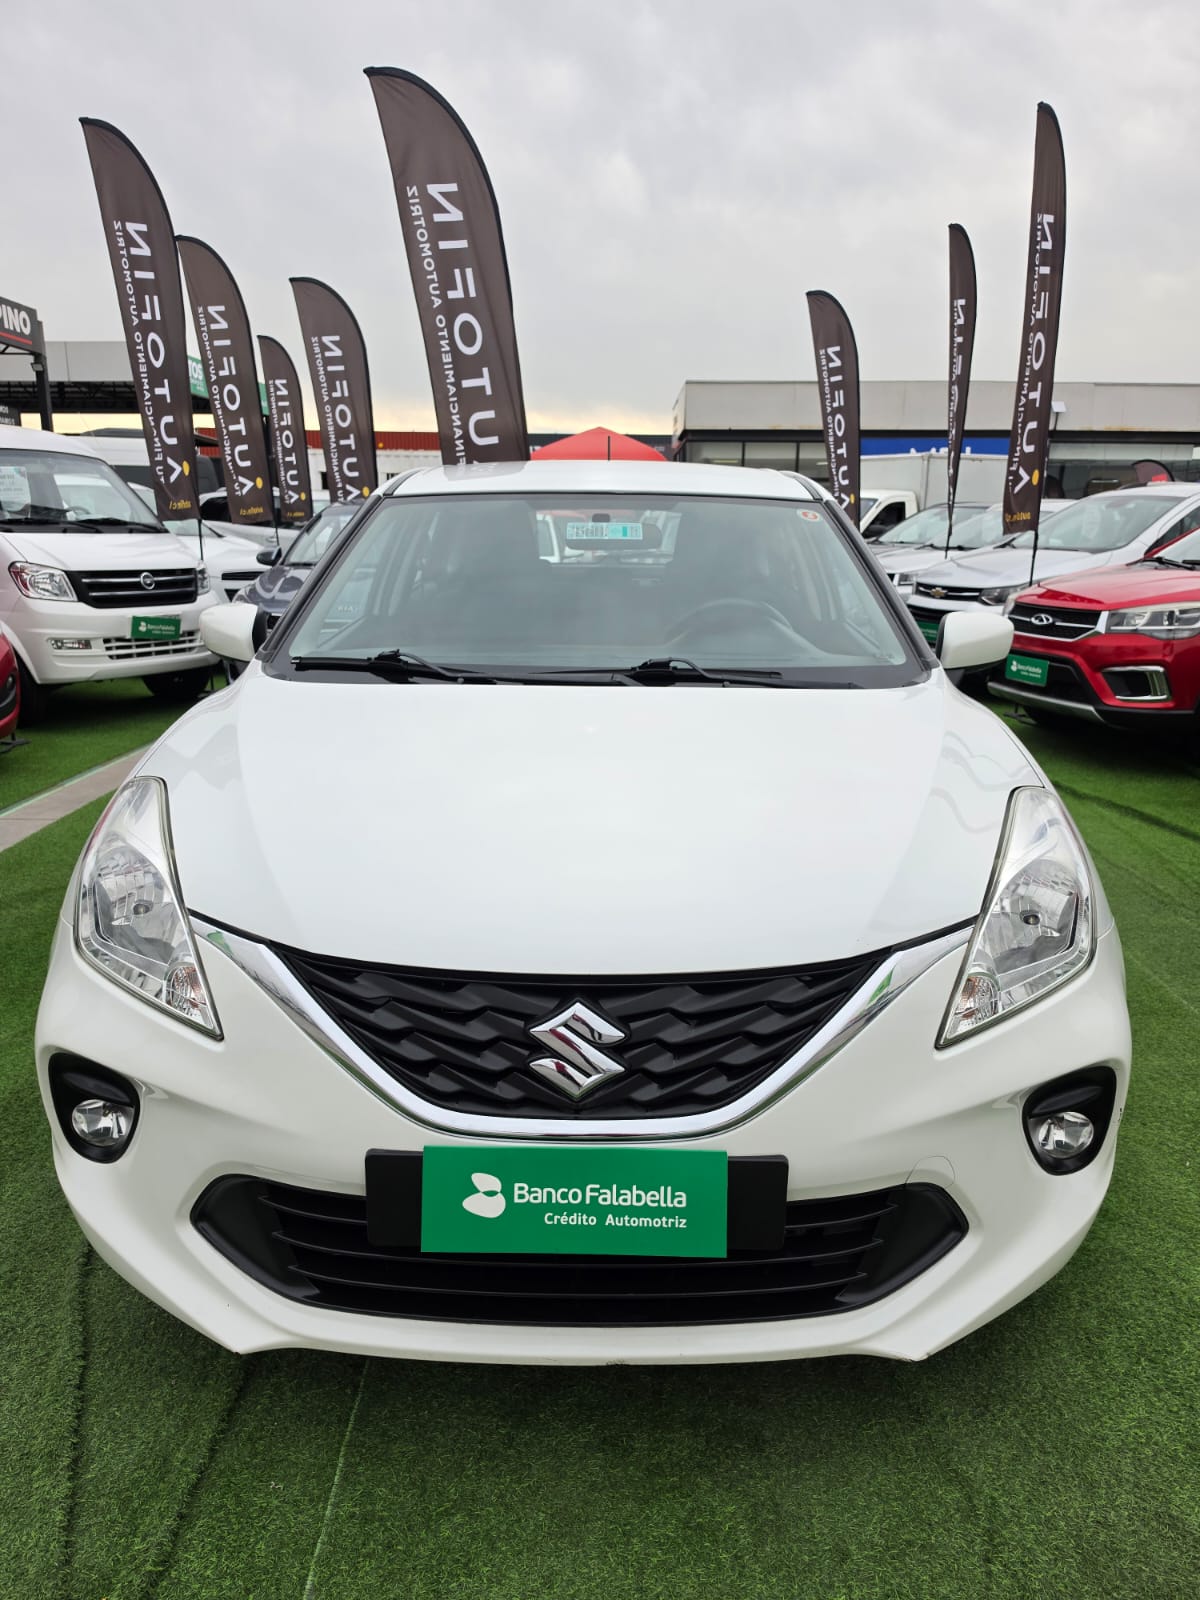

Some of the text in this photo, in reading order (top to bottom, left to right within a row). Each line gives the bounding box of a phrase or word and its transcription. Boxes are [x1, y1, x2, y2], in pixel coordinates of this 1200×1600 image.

[514, 1182, 687, 1208] Banco Falabella
[544, 1211, 687, 1228] Crédito Automotriz
